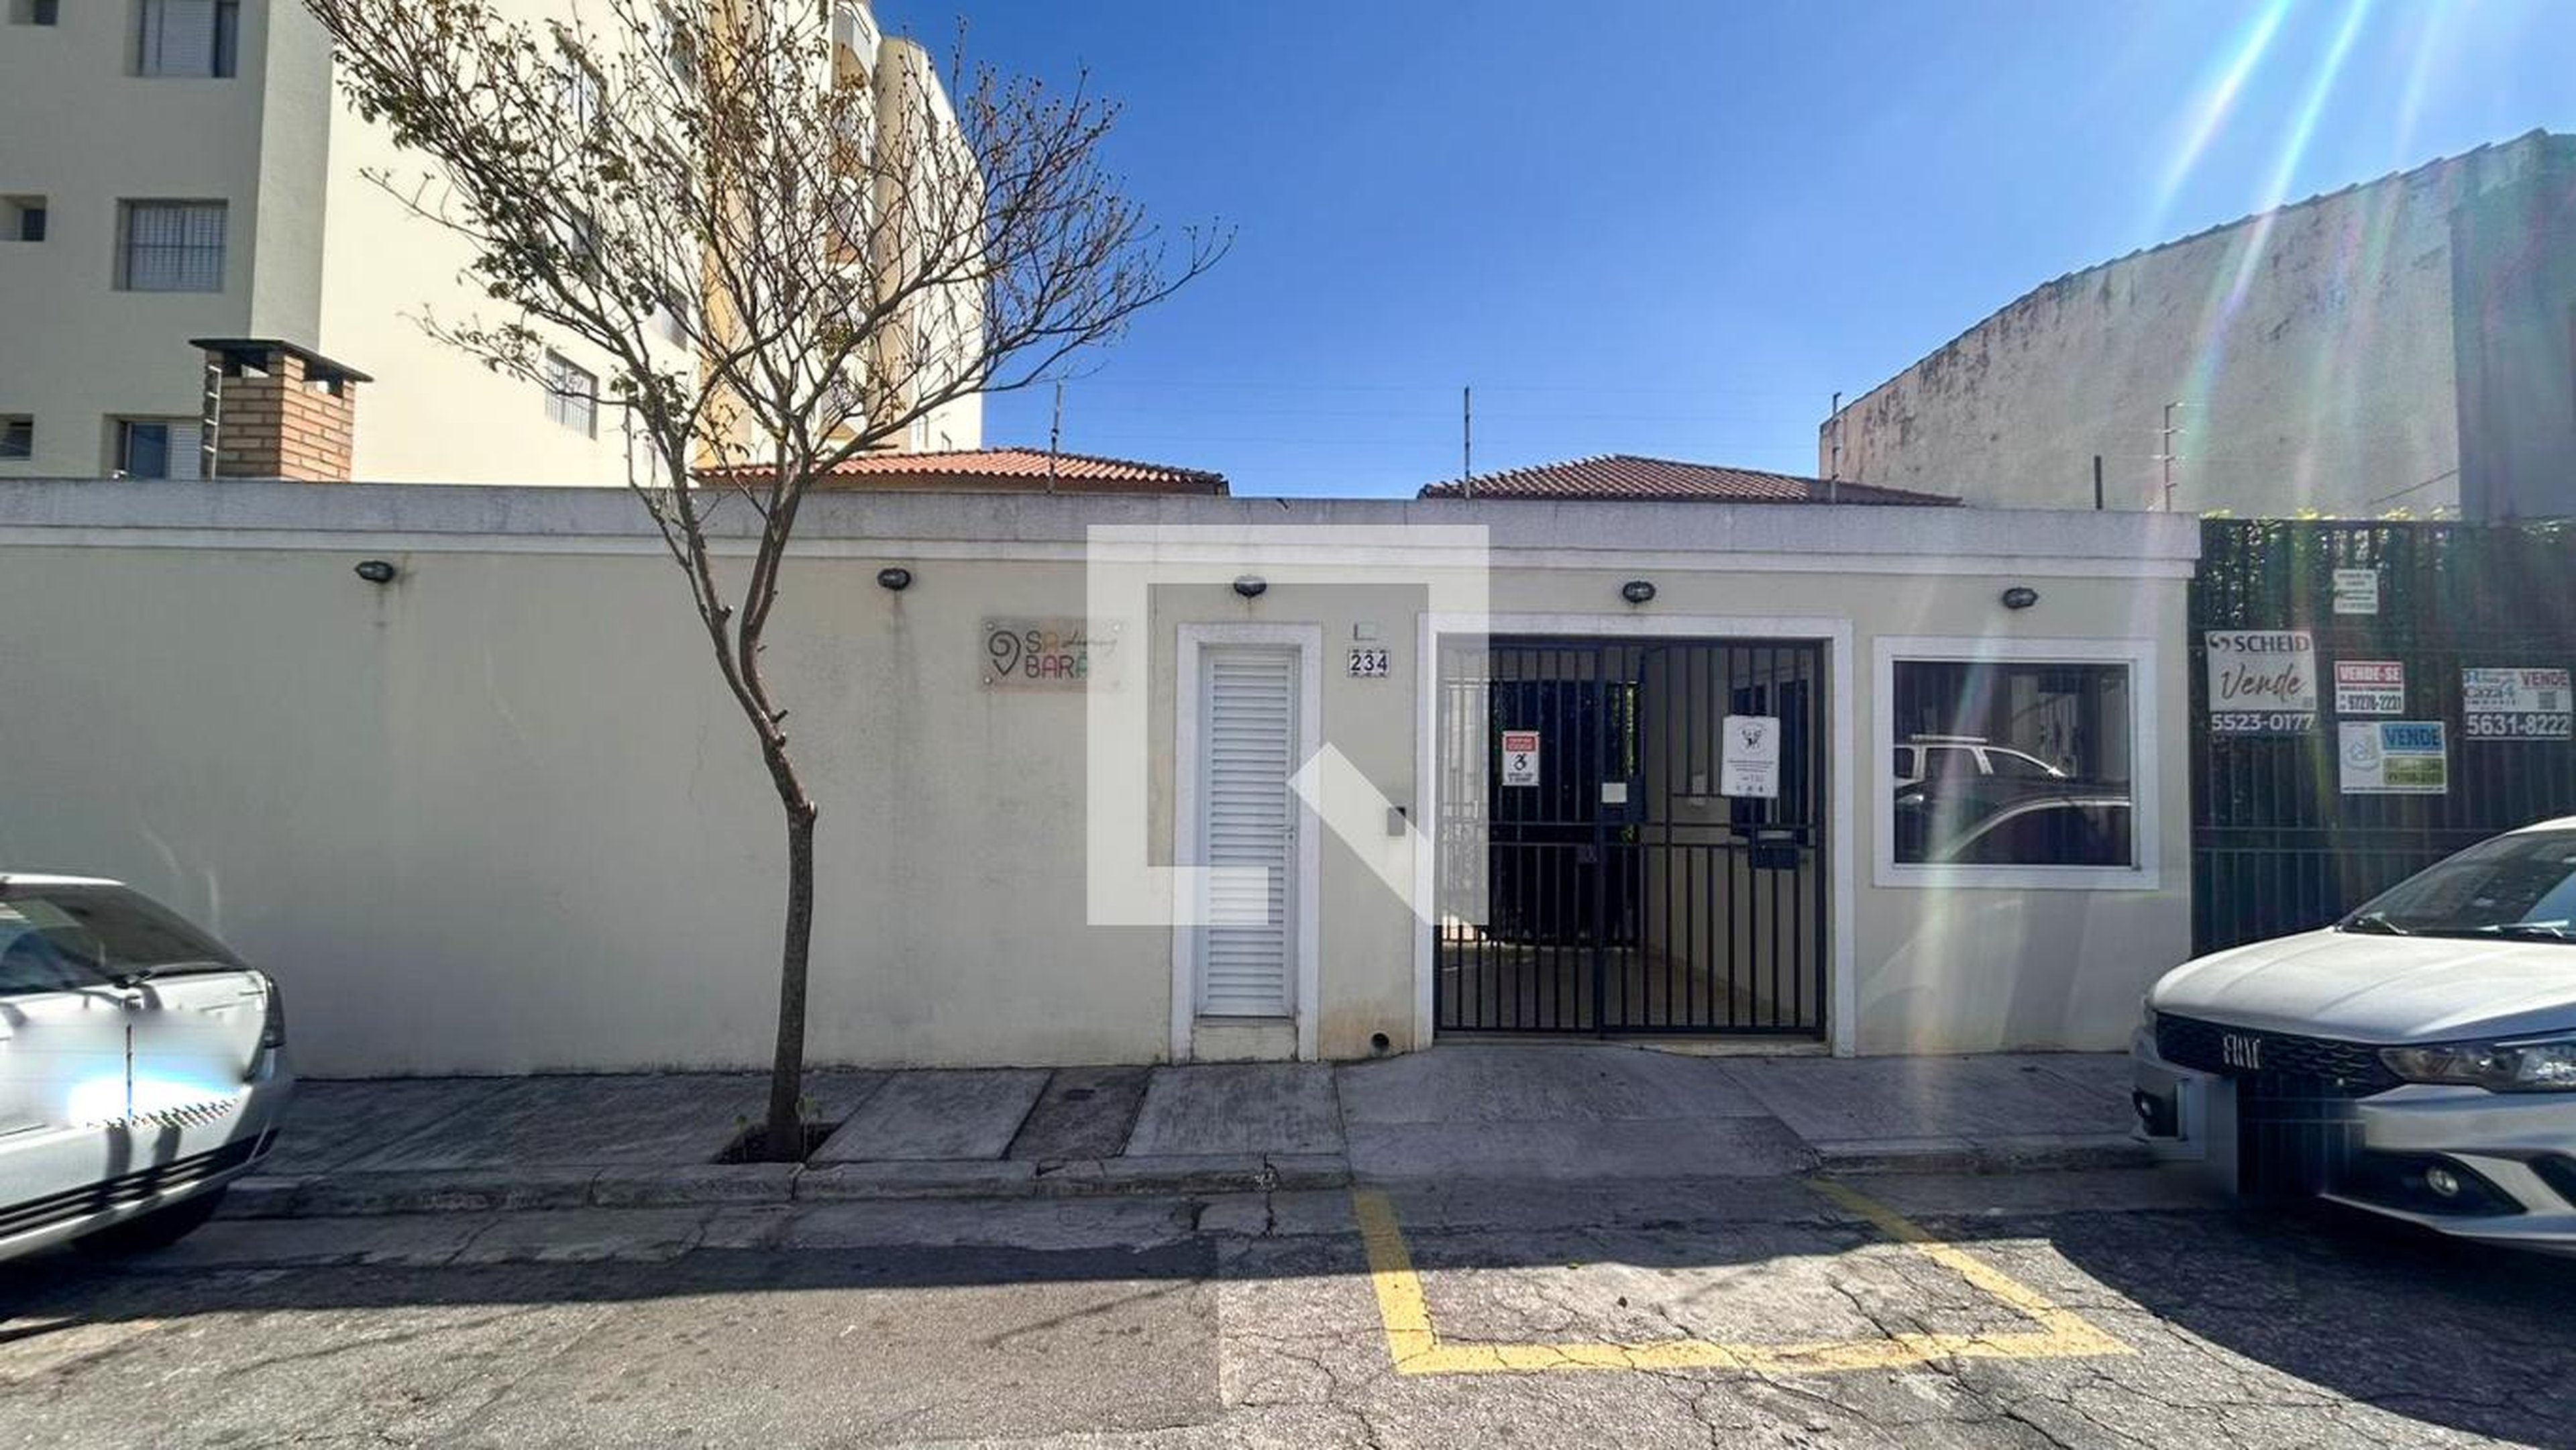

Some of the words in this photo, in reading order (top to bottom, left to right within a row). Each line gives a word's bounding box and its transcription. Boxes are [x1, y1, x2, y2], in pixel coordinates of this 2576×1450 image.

[2234, 635, 2310, 652] SCHEID
[1350, 654, 1388, 672] 234
[2220, 662, 2306, 703] Vende
[2339, 666, 2400, 681] VENDE-SE
[2520, 671, 2568, 686] VENDE
[2211, 713, 2315, 731] 5523-0177
[2467, 713, 2569, 735] 5631-8222
[2385, 727, 2441, 746] VENDE
